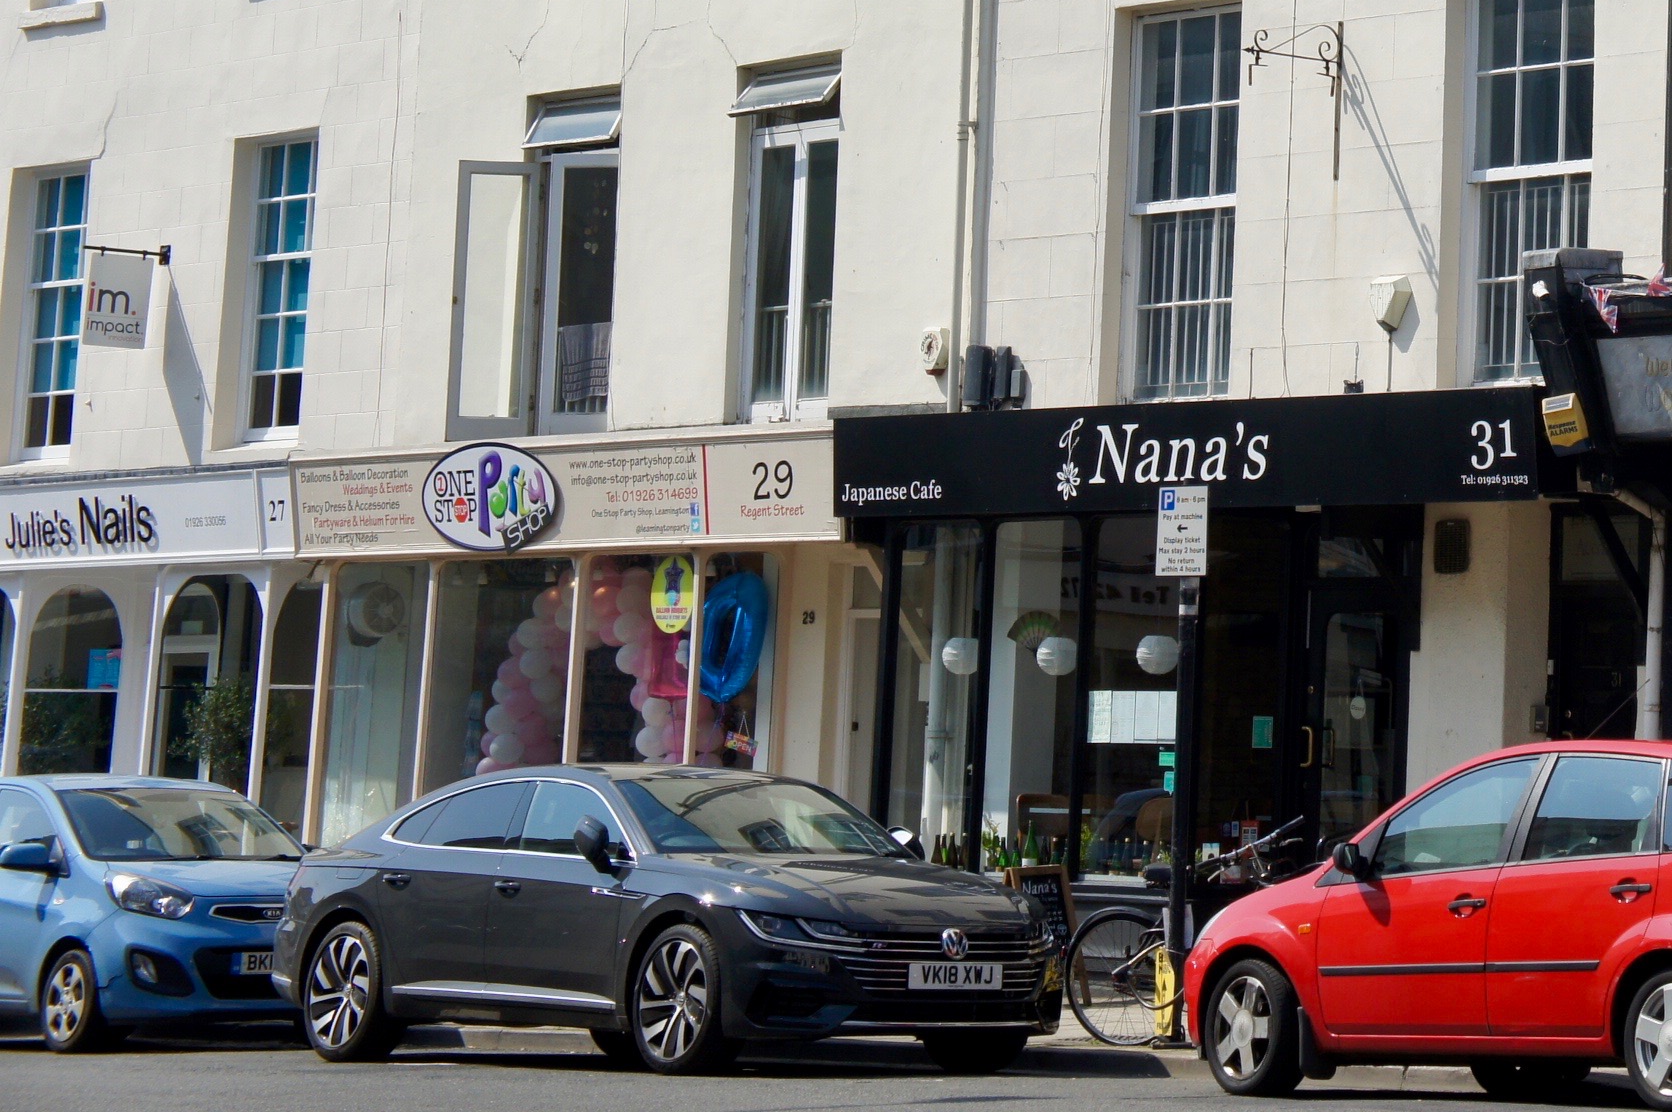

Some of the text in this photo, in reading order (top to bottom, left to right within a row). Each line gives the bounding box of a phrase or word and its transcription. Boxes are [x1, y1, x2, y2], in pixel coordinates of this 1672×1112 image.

[1550, 426, 1578, 437] ALARMS
[1471, 419, 1517, 470] 31
[569, 453, 696, 470] www.one-stop-partyshop.co.uk
[1089, 422, 1269, 486] Nana's
[301, 468, 408, 484] Balloons & Balloon Decoration
[434, 470, 475, 497] ONE
[571, 469, 697, 487] info@one-stop-partyshop.co.uk
[752, 460, 793, 500] 29
[1461, 475, 1529, 486] Tel: 01926 311323
[343, 482, 413, 497] Weddings & Events
[478, 450, 546, 538] Party
[606, 488, 698, 502] Tel: 01926 314699
[842, 480, 942, 506] Japanese Cafe
[302, 499, 400, 515] Fancy Dress & Accessories
[1164, 492, 1174, 509] P
[268, 500, 285, 522] 27
[591, 509, 602, 518] One
[604, 508, 619, 519] Stop
[620, 508, 636, 518] Party
[741, 504, 804, 520] Regent Street
[6, 494, 154, 549] Julie's Nails
[313, 514, 415, 530] Partyware & Helium For Hire
[507, 506, 547, 547] SHOP
[305, 532, 378, 546] All Your Party Needs
[1164, 537, 1183, 545] Display
[803, 611, 815, 624] 29
[1022, 880, 1058, 894] Nana's
[922, 965, 993, 984] VK18 XWJ
